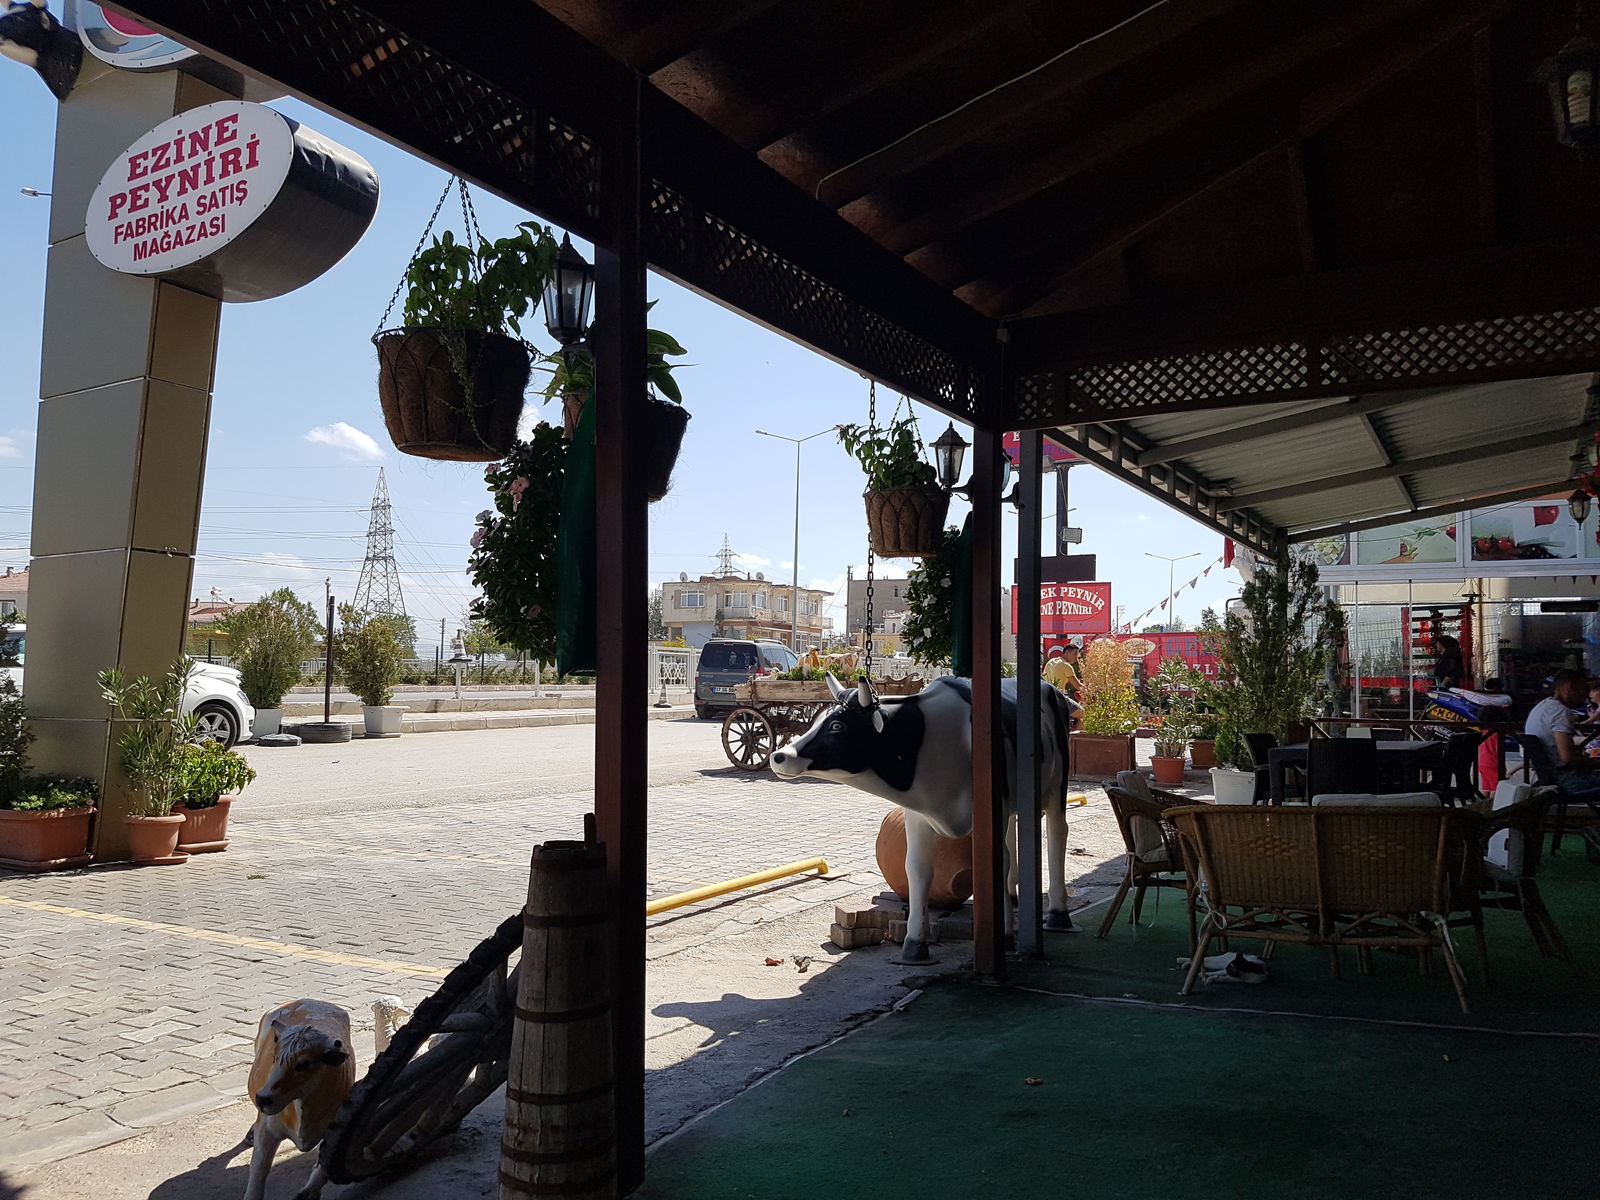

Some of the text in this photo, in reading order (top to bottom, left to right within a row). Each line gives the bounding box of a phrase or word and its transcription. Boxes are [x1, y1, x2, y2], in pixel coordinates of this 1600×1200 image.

[127, 113, 239, 182] EZİNE
[107, 133, 260, 221] PEYNİRİ
[114, 180, 248, 245] FABRİKA SATIŞ
[133, 213, 226, 261] MAĞAZASI
[1056, 601, 1092, 615] PEYNİRİ
[1059, 586, 1105, 611] PEYNİR
